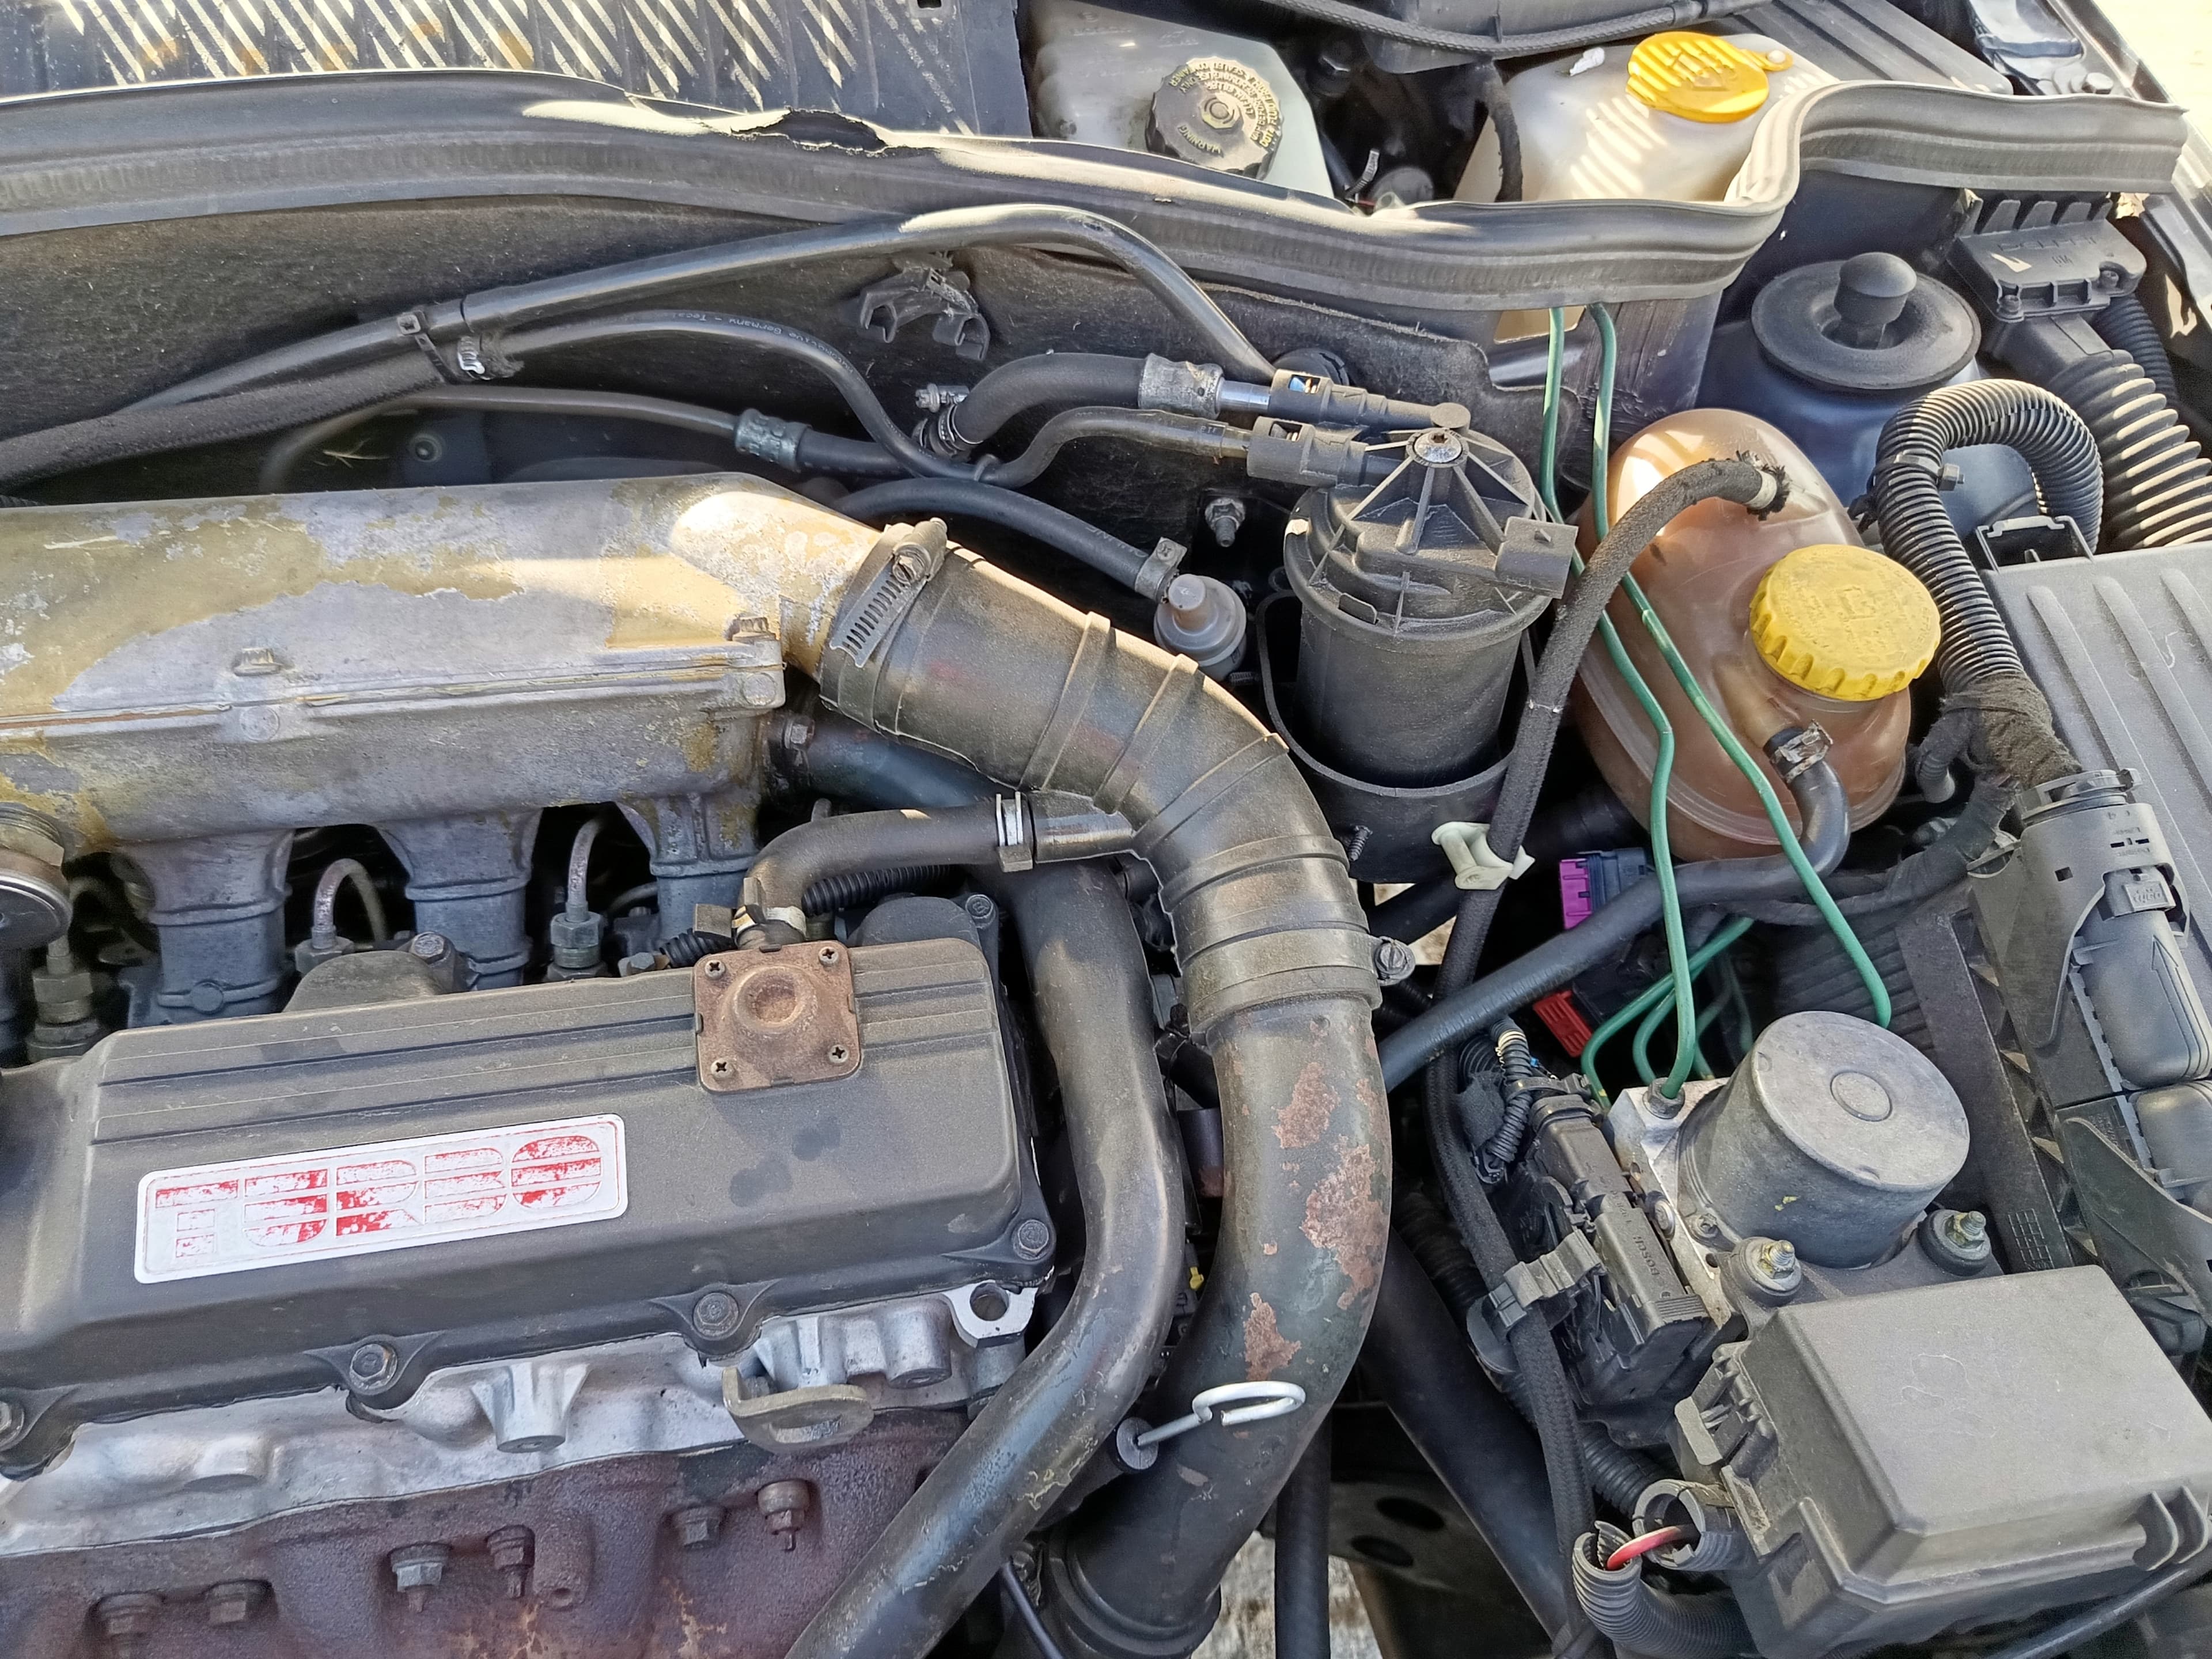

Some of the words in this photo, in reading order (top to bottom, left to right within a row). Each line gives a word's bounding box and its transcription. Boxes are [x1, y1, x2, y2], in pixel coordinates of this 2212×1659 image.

[1180, 77, 1197, 93] ONLY
[1179, 125, 1221, 154] WARNING
[728, 317, 782, 335] Germany
[154, 1134, 603, 1259] TURBO
[1633, 1234, 1661, 1276] BOSCH
